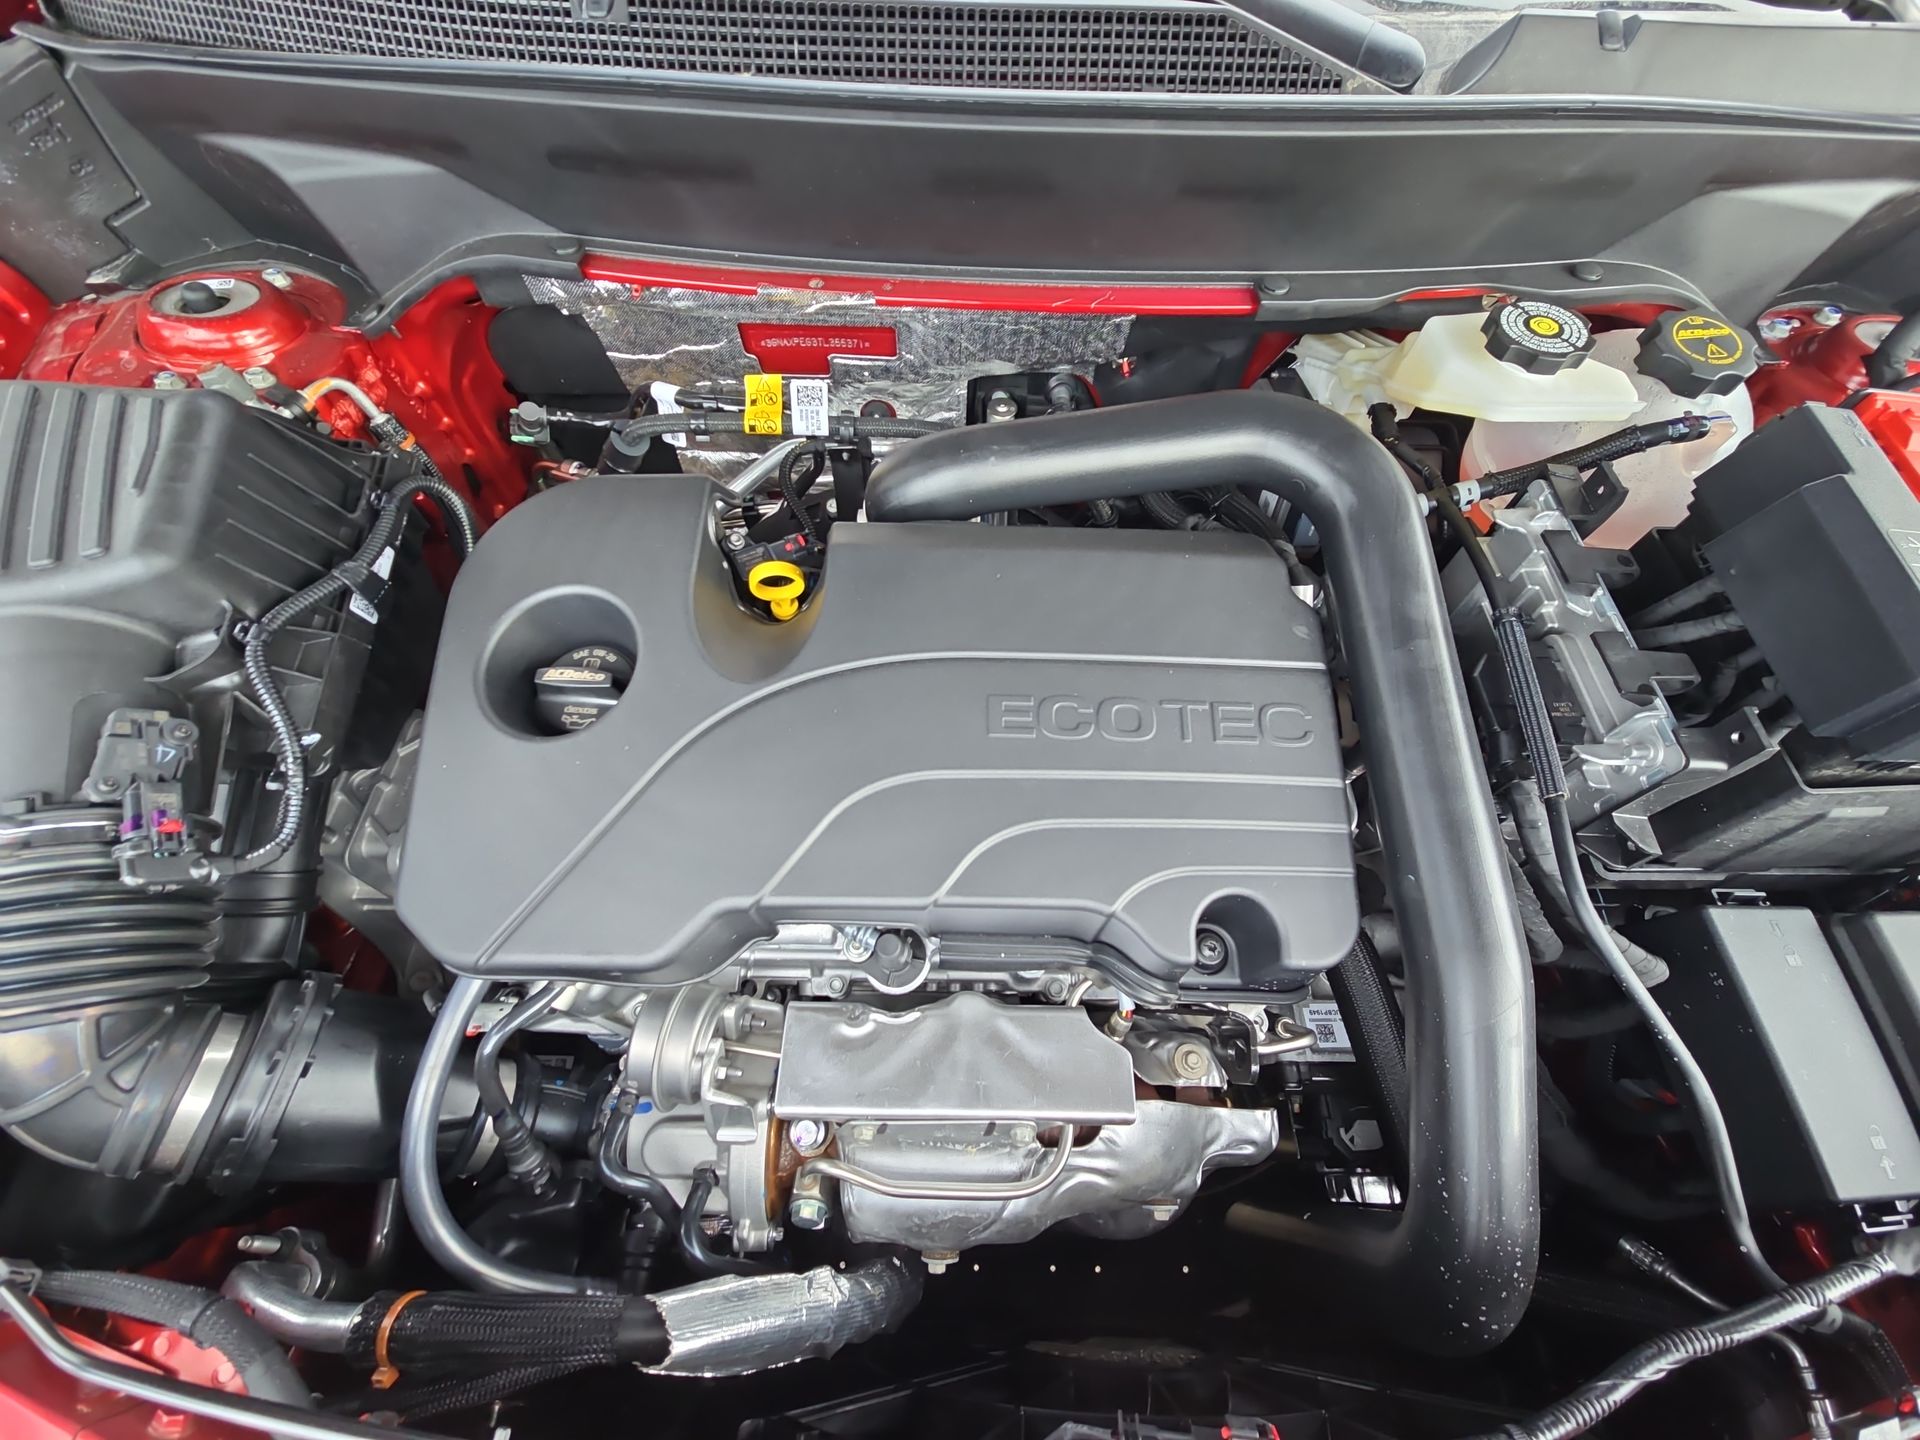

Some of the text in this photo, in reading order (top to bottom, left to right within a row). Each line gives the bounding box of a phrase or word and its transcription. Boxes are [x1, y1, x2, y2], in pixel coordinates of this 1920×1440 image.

[573, 649, 590, 660] SAE
[542, 668, 606, 681] ACDelco
[986, 693, 1315, 749] ECOTEC
